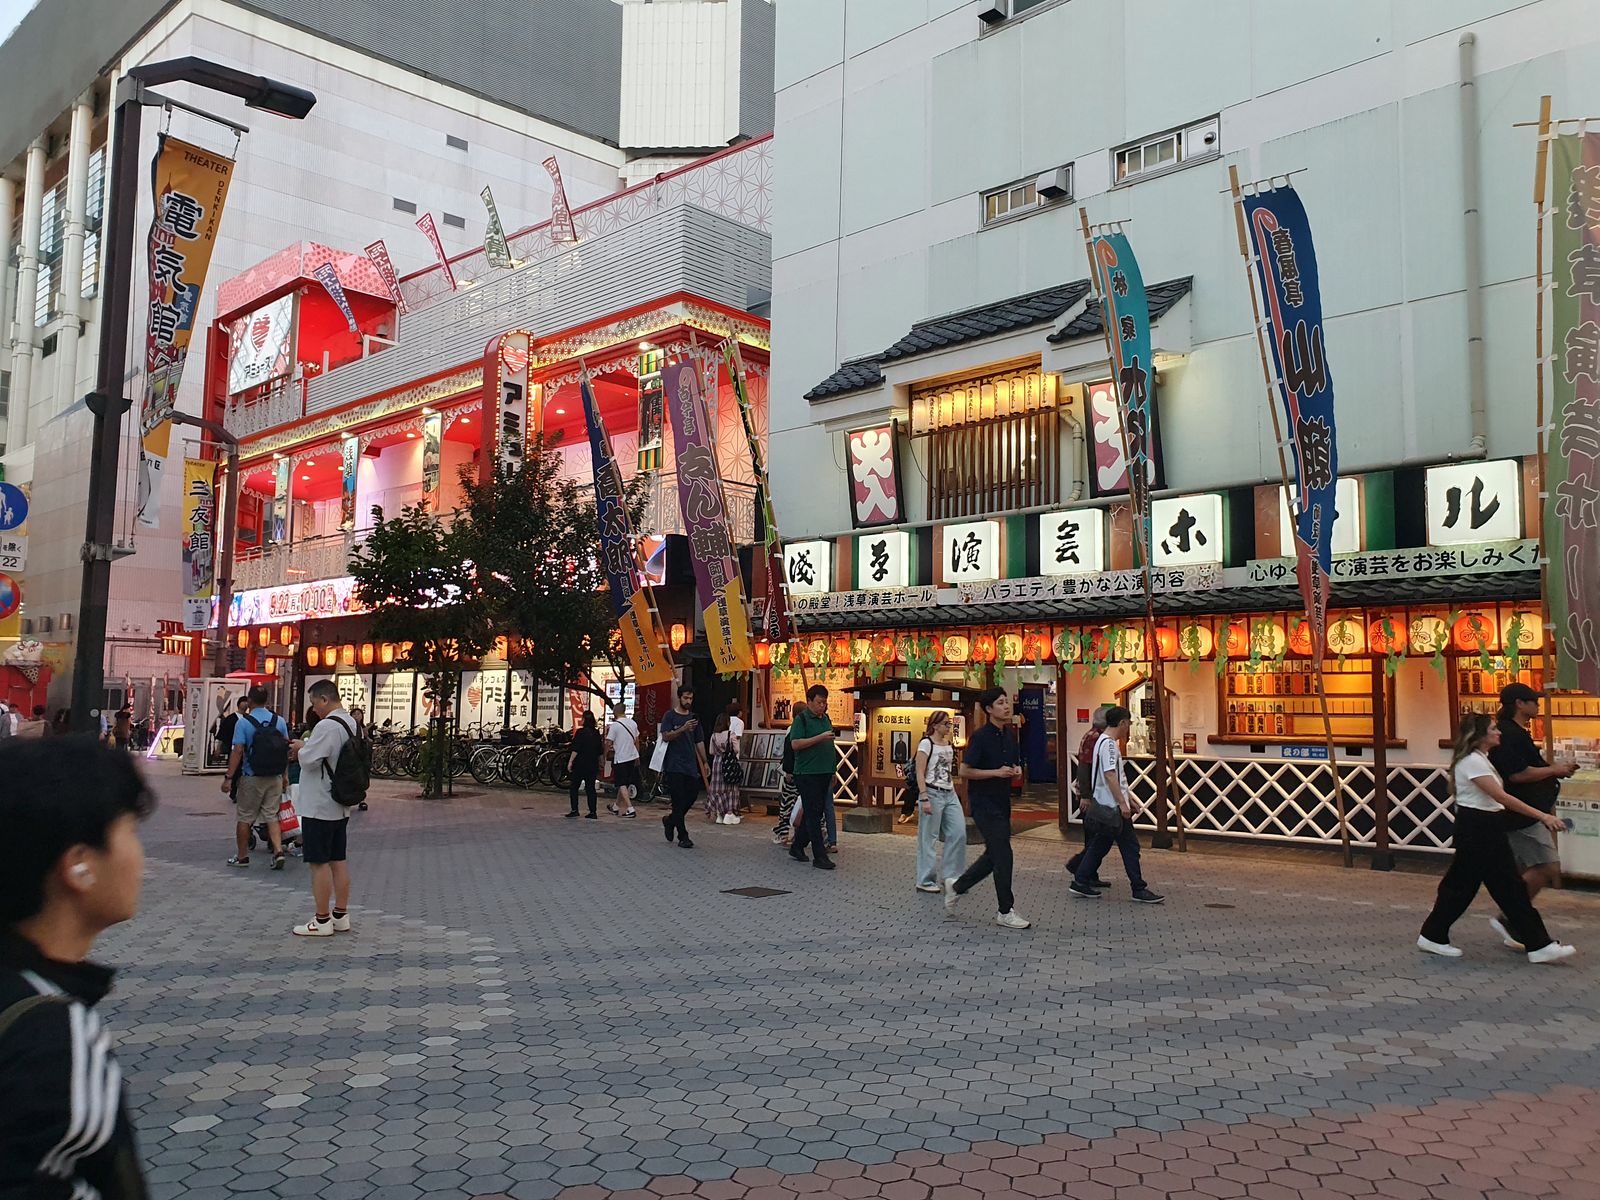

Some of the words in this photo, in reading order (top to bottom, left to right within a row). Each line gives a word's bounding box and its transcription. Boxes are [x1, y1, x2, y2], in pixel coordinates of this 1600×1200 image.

[184, 150, 229, 176] THEATER
[204, 180, 225, 241] DENKIKAN
[151, 192, 203, 344] 電気館
[189, 480, 210, 551] 三友館
[983, 570, 1186, 600] バラエティ豊かな公演内容
[715, 597, 737, 662] 浅草演芸ホール
[719, 646, 729, 665] より
